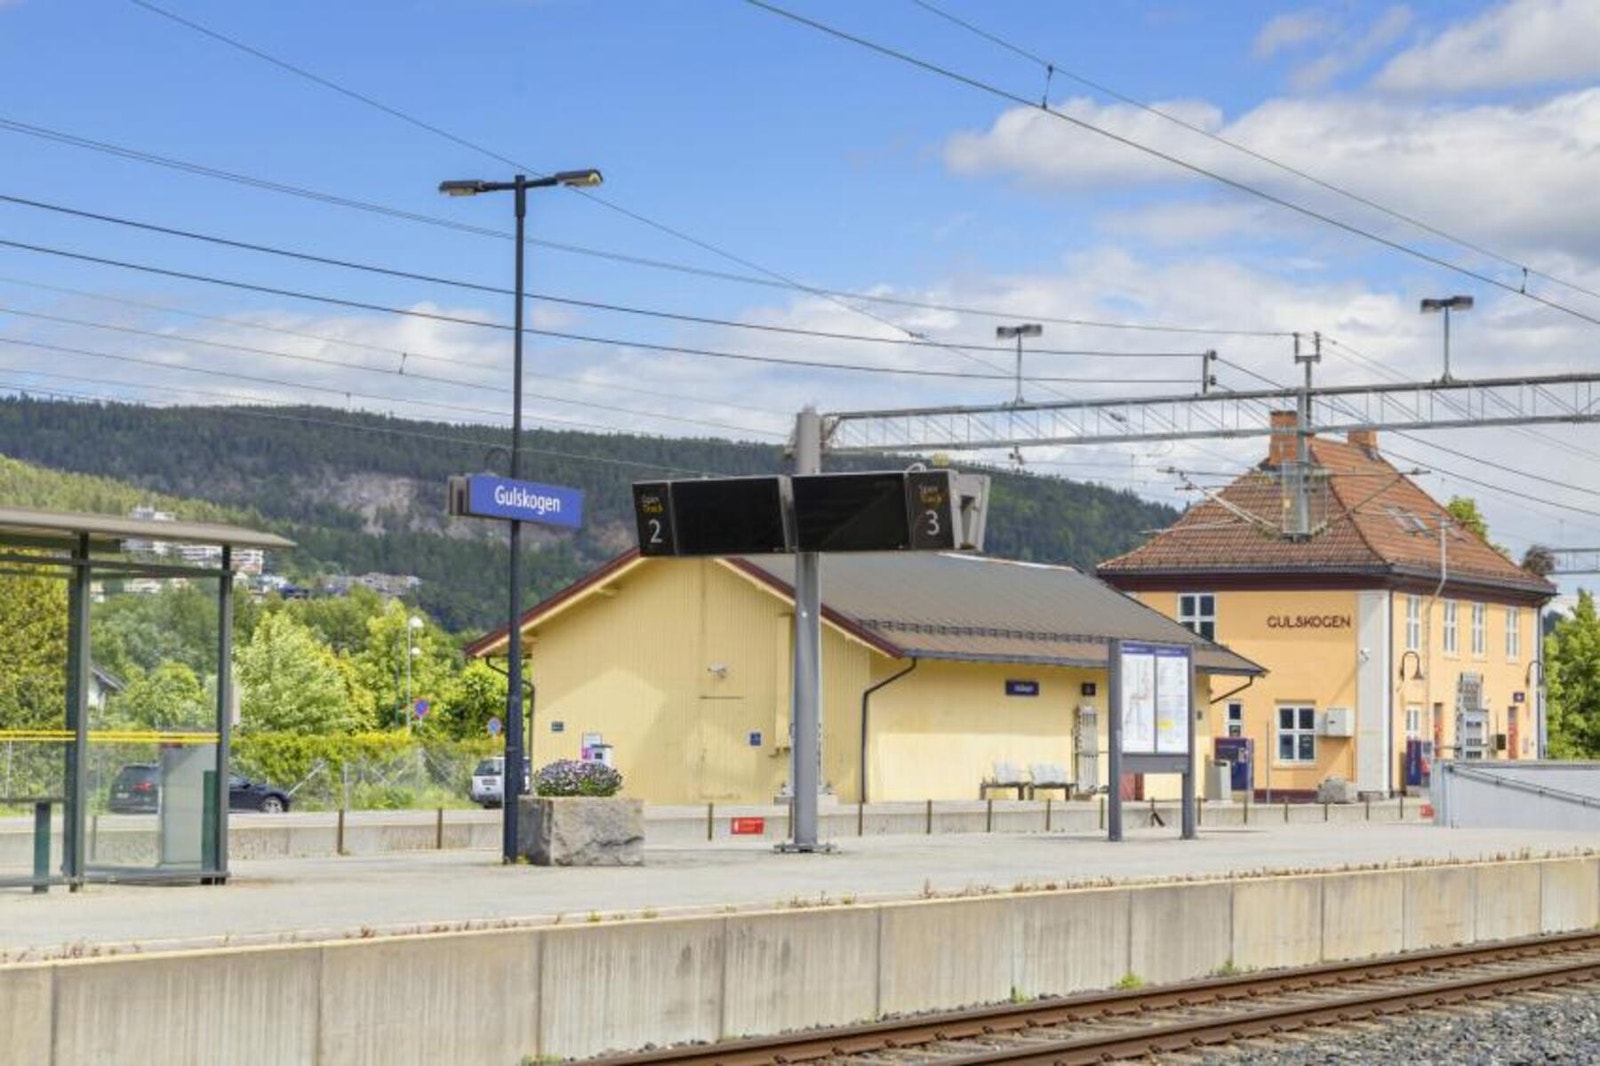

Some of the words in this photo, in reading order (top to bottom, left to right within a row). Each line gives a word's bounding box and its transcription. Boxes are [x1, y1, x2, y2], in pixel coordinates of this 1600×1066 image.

[494, 485, 561, 515] Gulskogen
[649, 519, 662, 543] 2
[925, 510, 940, 535] 3
[1266, 615, 1351, 628] GULSKOGEN
